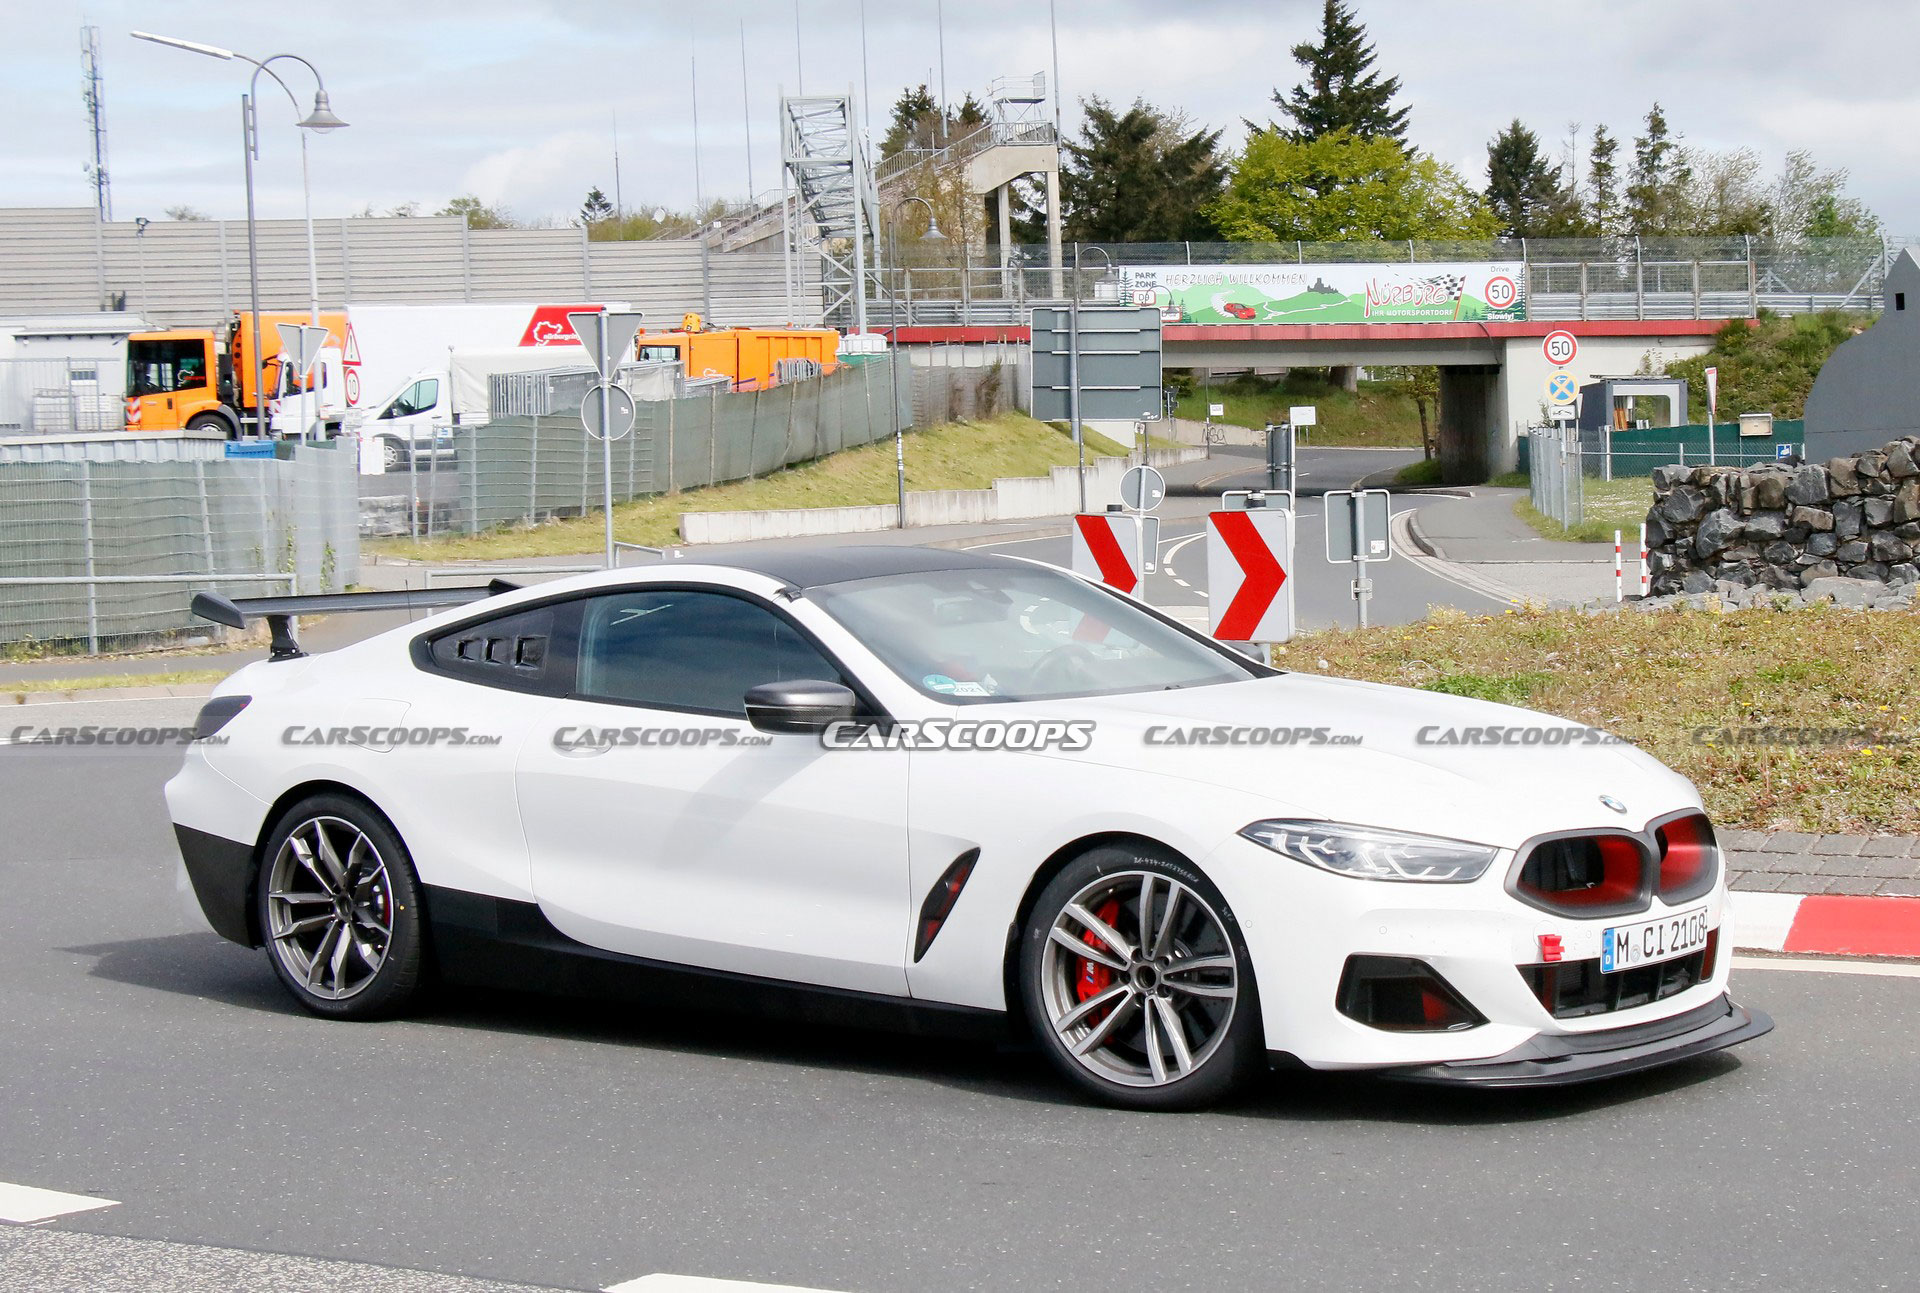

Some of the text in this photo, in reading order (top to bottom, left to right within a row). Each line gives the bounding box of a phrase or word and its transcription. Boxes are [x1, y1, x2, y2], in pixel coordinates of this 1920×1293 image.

[1165, 272, 1308, 286] HERZLICH WILLKOMMEN
[1365, 276, 1449, 318] NÜRBURG
[1491, 284, 1510, 300] 50
[1386, 309, 1454, 317] MOTORSPORTDORF
[1487, 312, 1515, 321] Slowly!
[1551, 340, 1570, 356] 50
[348, 379, 357, 395] 10
[1616, 912, 1706, 964] M CI 2108
[1605, 954, 1611, 965] D
